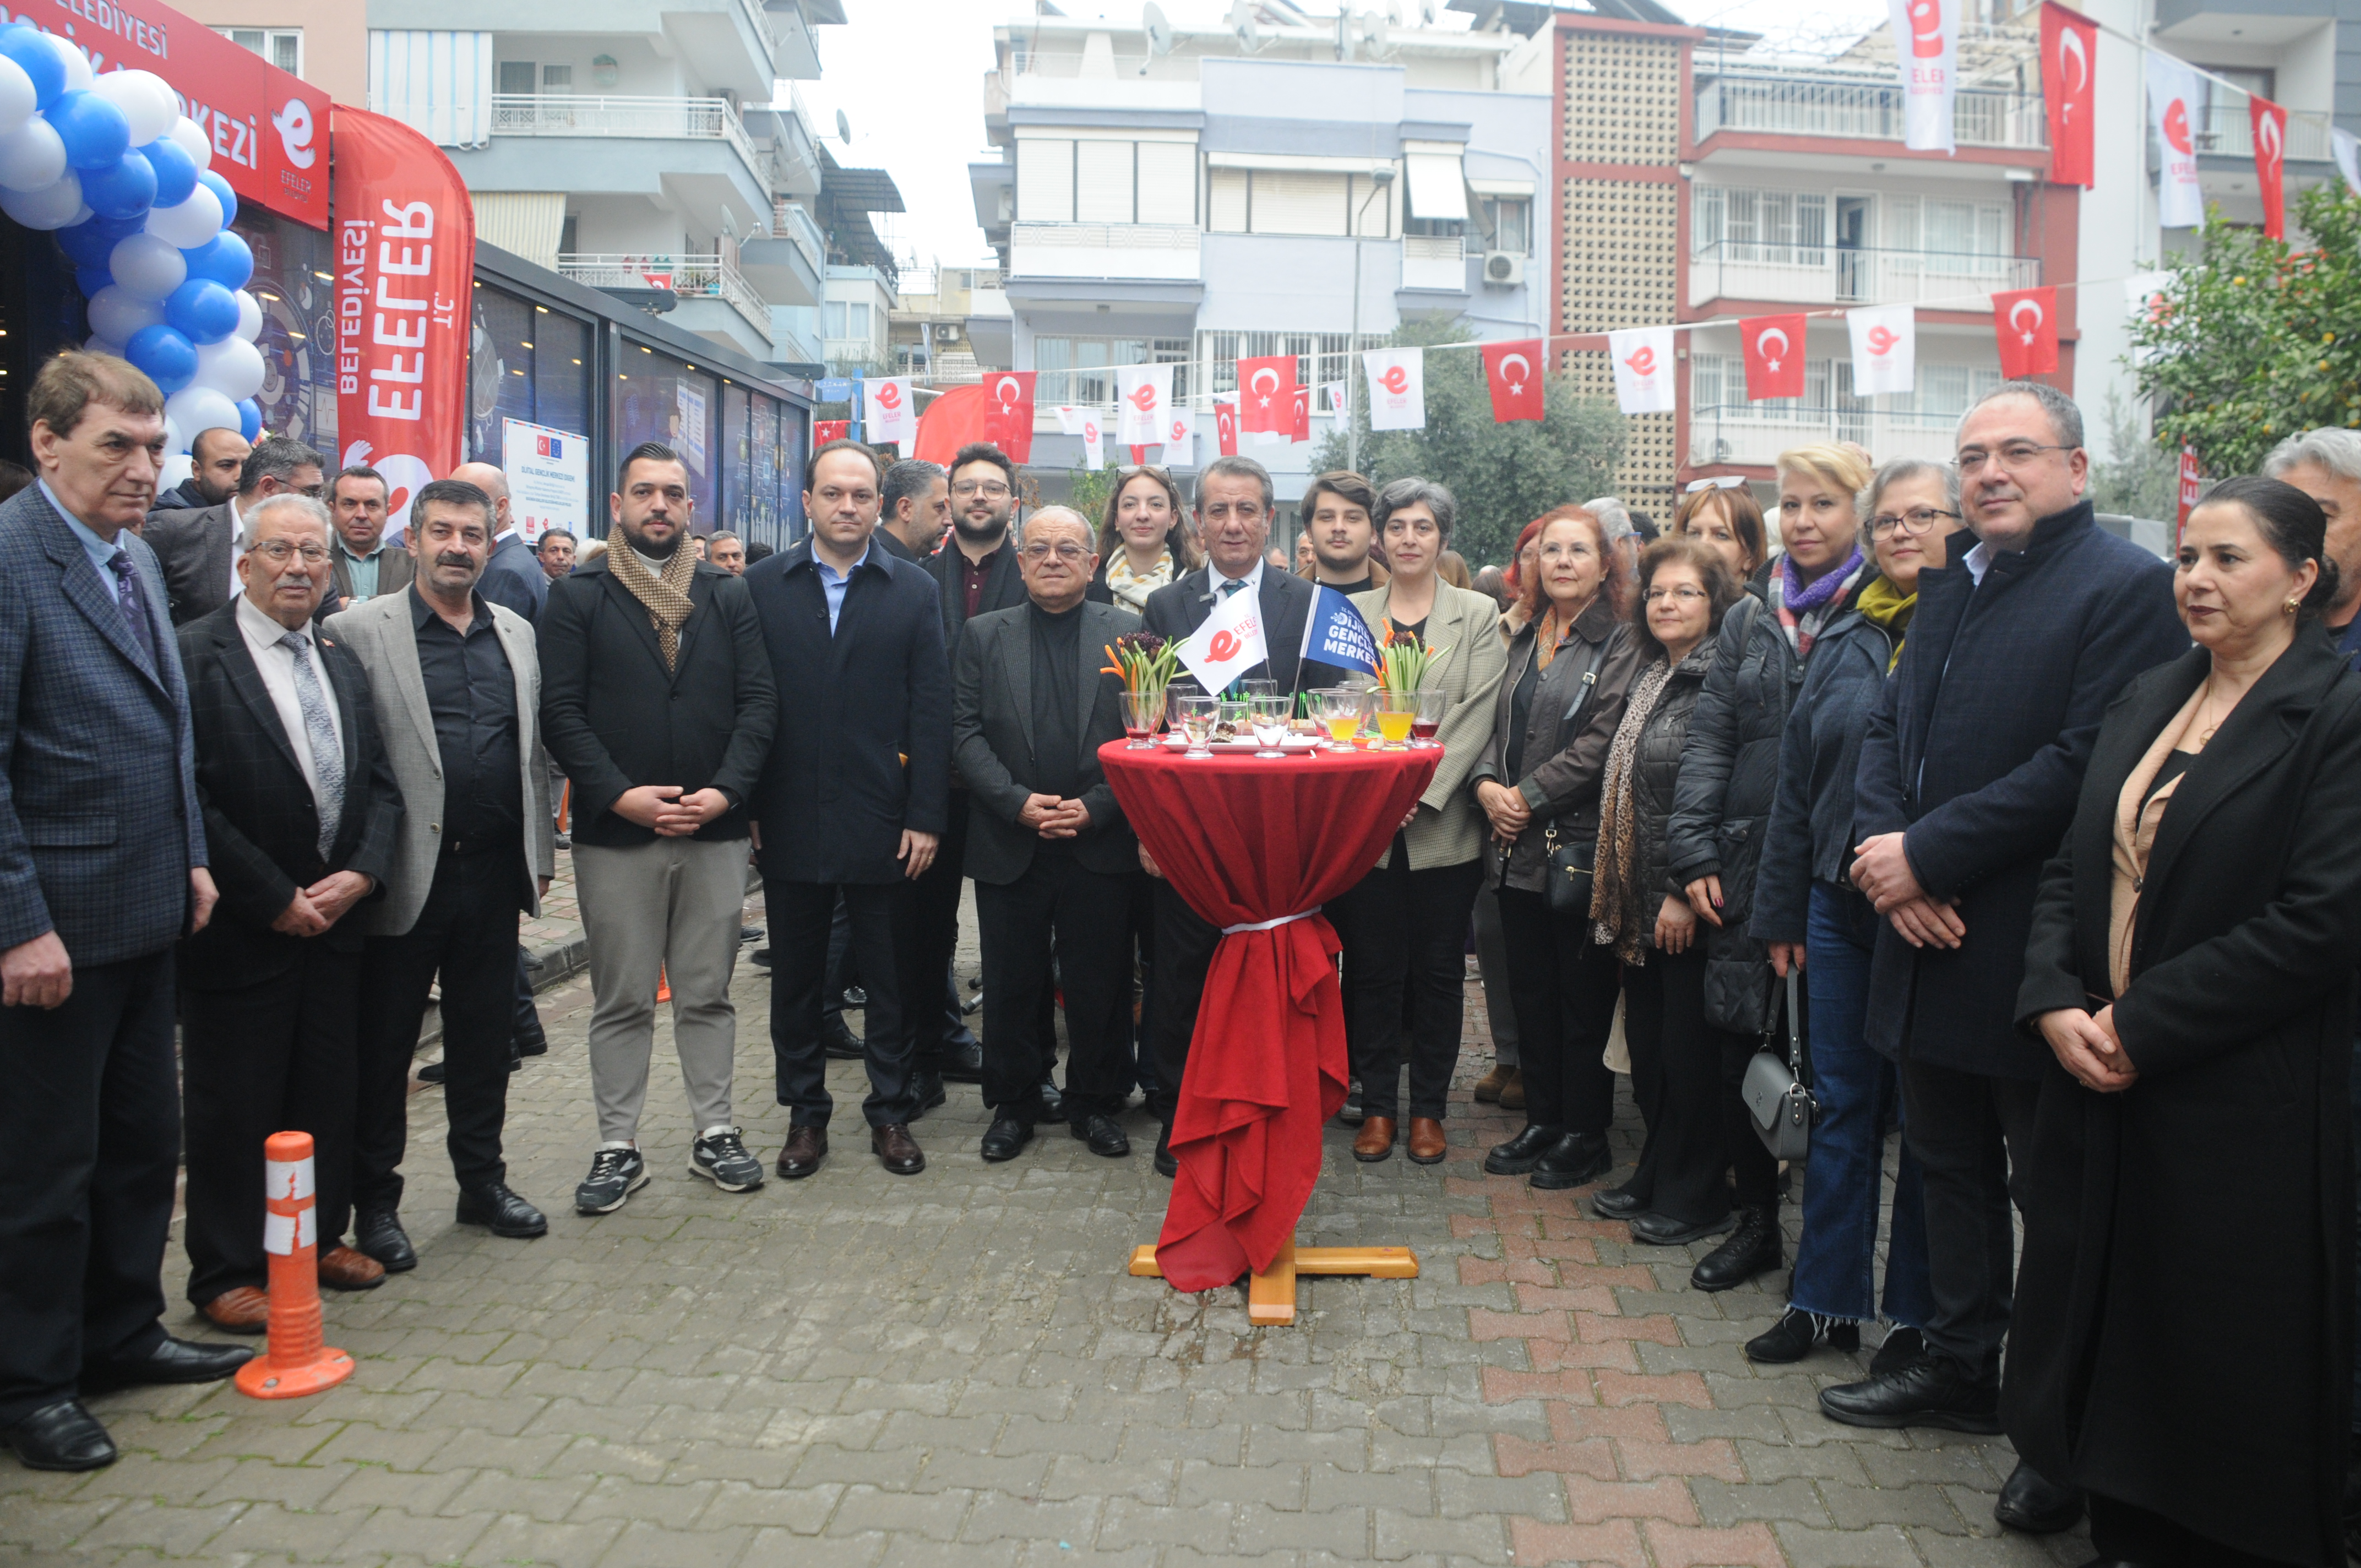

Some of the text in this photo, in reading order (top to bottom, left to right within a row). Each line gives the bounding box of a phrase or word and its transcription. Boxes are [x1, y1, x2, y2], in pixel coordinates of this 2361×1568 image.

[55, 0, 168, 59] LEDİYESİ
[281, 168, 312, 193] EFELER
[883, 411, 901, 420] EFELER
